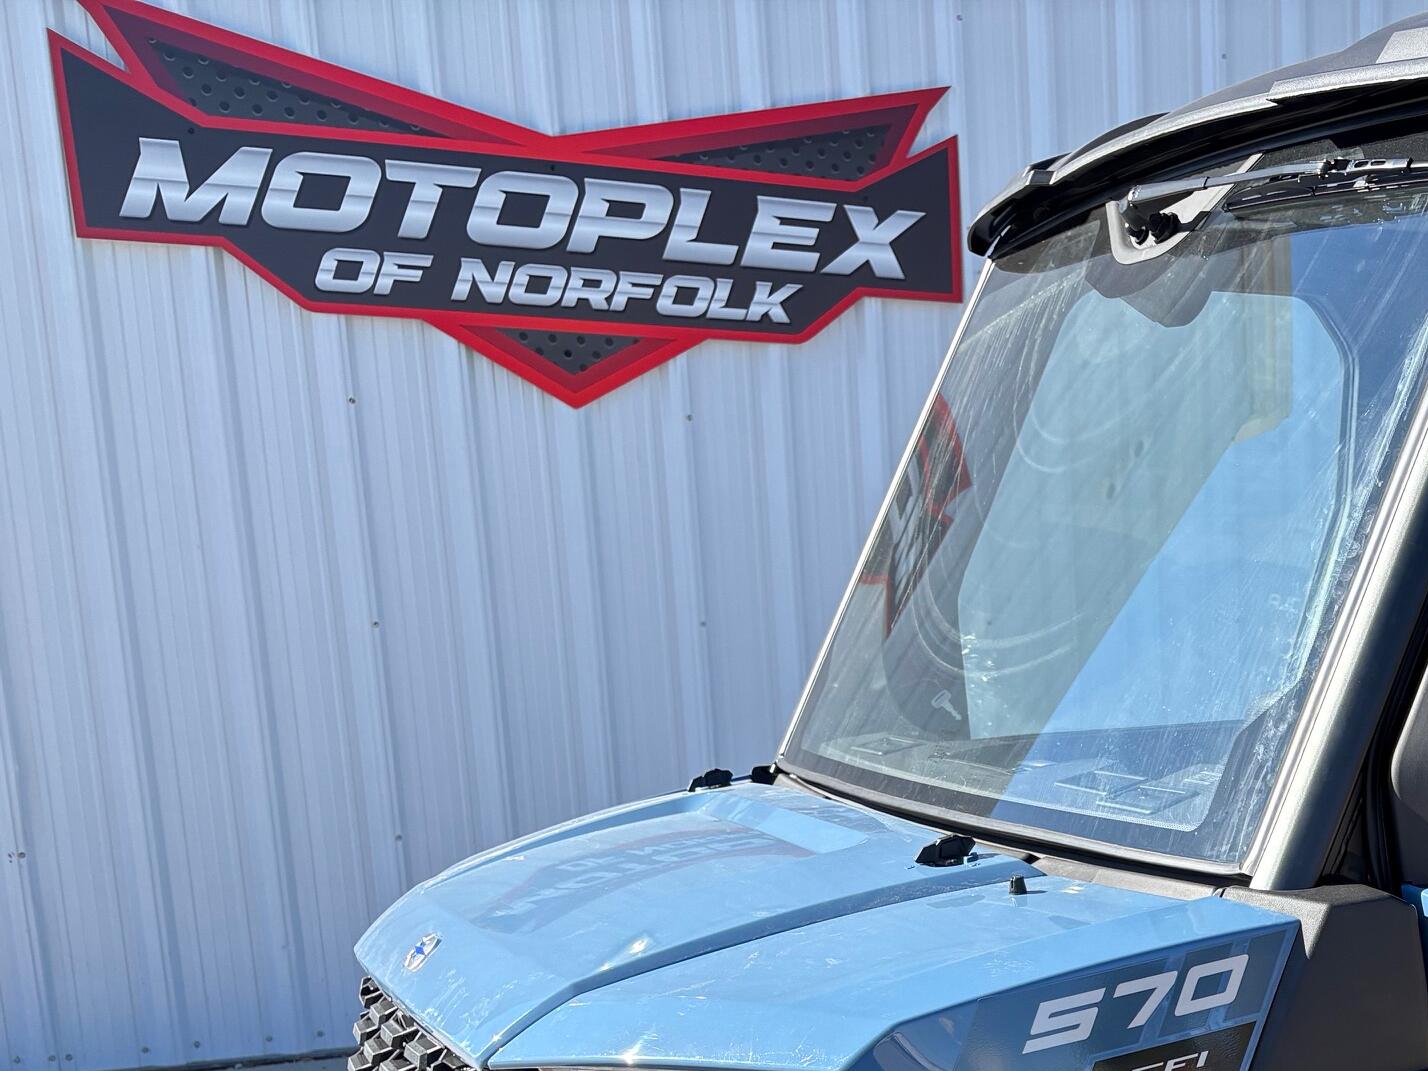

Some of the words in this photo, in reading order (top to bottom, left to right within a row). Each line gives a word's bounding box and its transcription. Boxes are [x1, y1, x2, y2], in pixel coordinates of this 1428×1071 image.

[118, 136, 927, 280] MOTOPLEX
[314, 247, 434, 296] OF
[451, 257, 804, 324] NORFOLK
[1022, 953, 1250, 1055] 570
